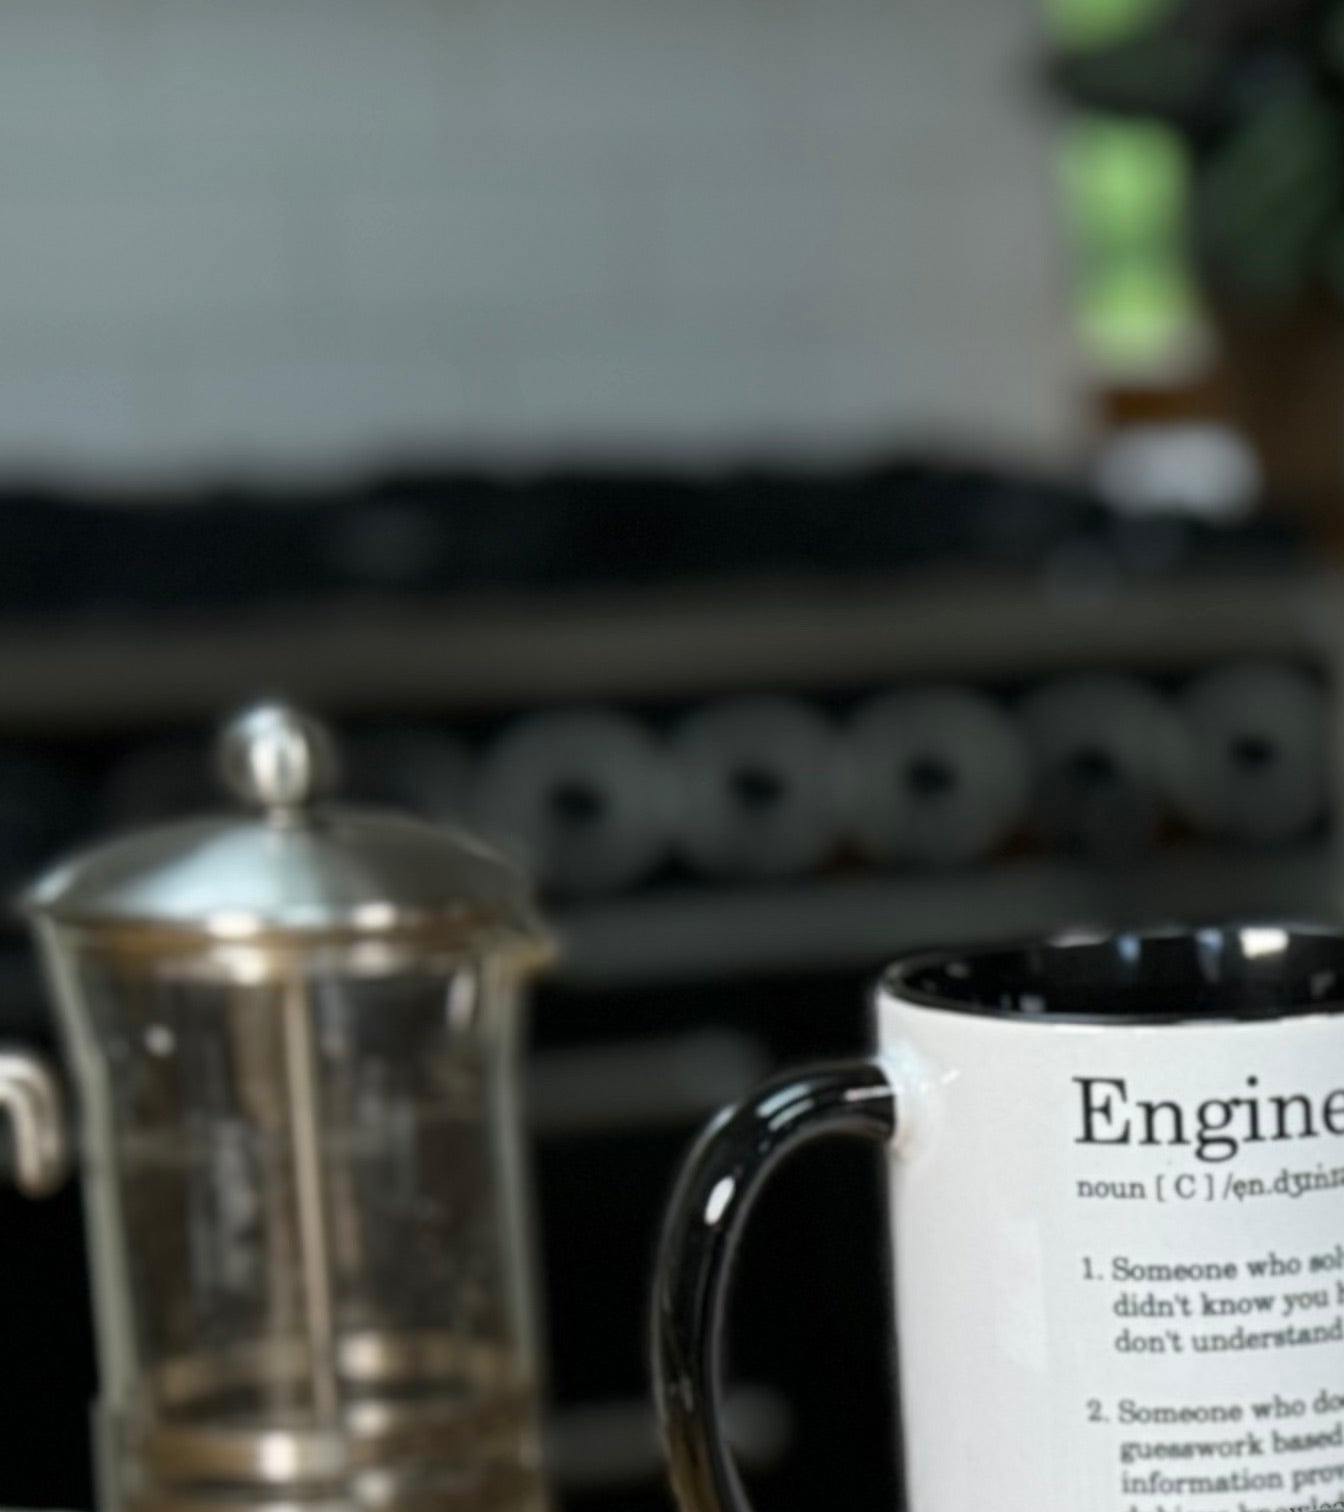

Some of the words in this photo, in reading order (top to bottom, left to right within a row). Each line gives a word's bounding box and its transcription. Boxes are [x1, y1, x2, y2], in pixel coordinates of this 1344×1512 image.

[1077, 1178, 1146, 1199] noun
[1082, 1257, 1102, 1281] 1.
[1112, 1257, 1237, 1281] Someone
[1247, 1253, 1301, 1276] who
[1114, 1293, 1191, 1318] didn't
[1200, 1293, 1274, 1316] know
[1282, 1288, 1329, 1316] you
[1115, 1328, 1182, 1353] don't
[1191, 1317, 1344, 1352] understand
[1087, 1400, 1108, 1423] 2.
[1119, 1400, 1242, 1424] Someone
[1252, 1396, 1306, 1419] who
[1120, 1432, 1264, 1463] guesswork
[1273, 1425, 1343, 1455] based
